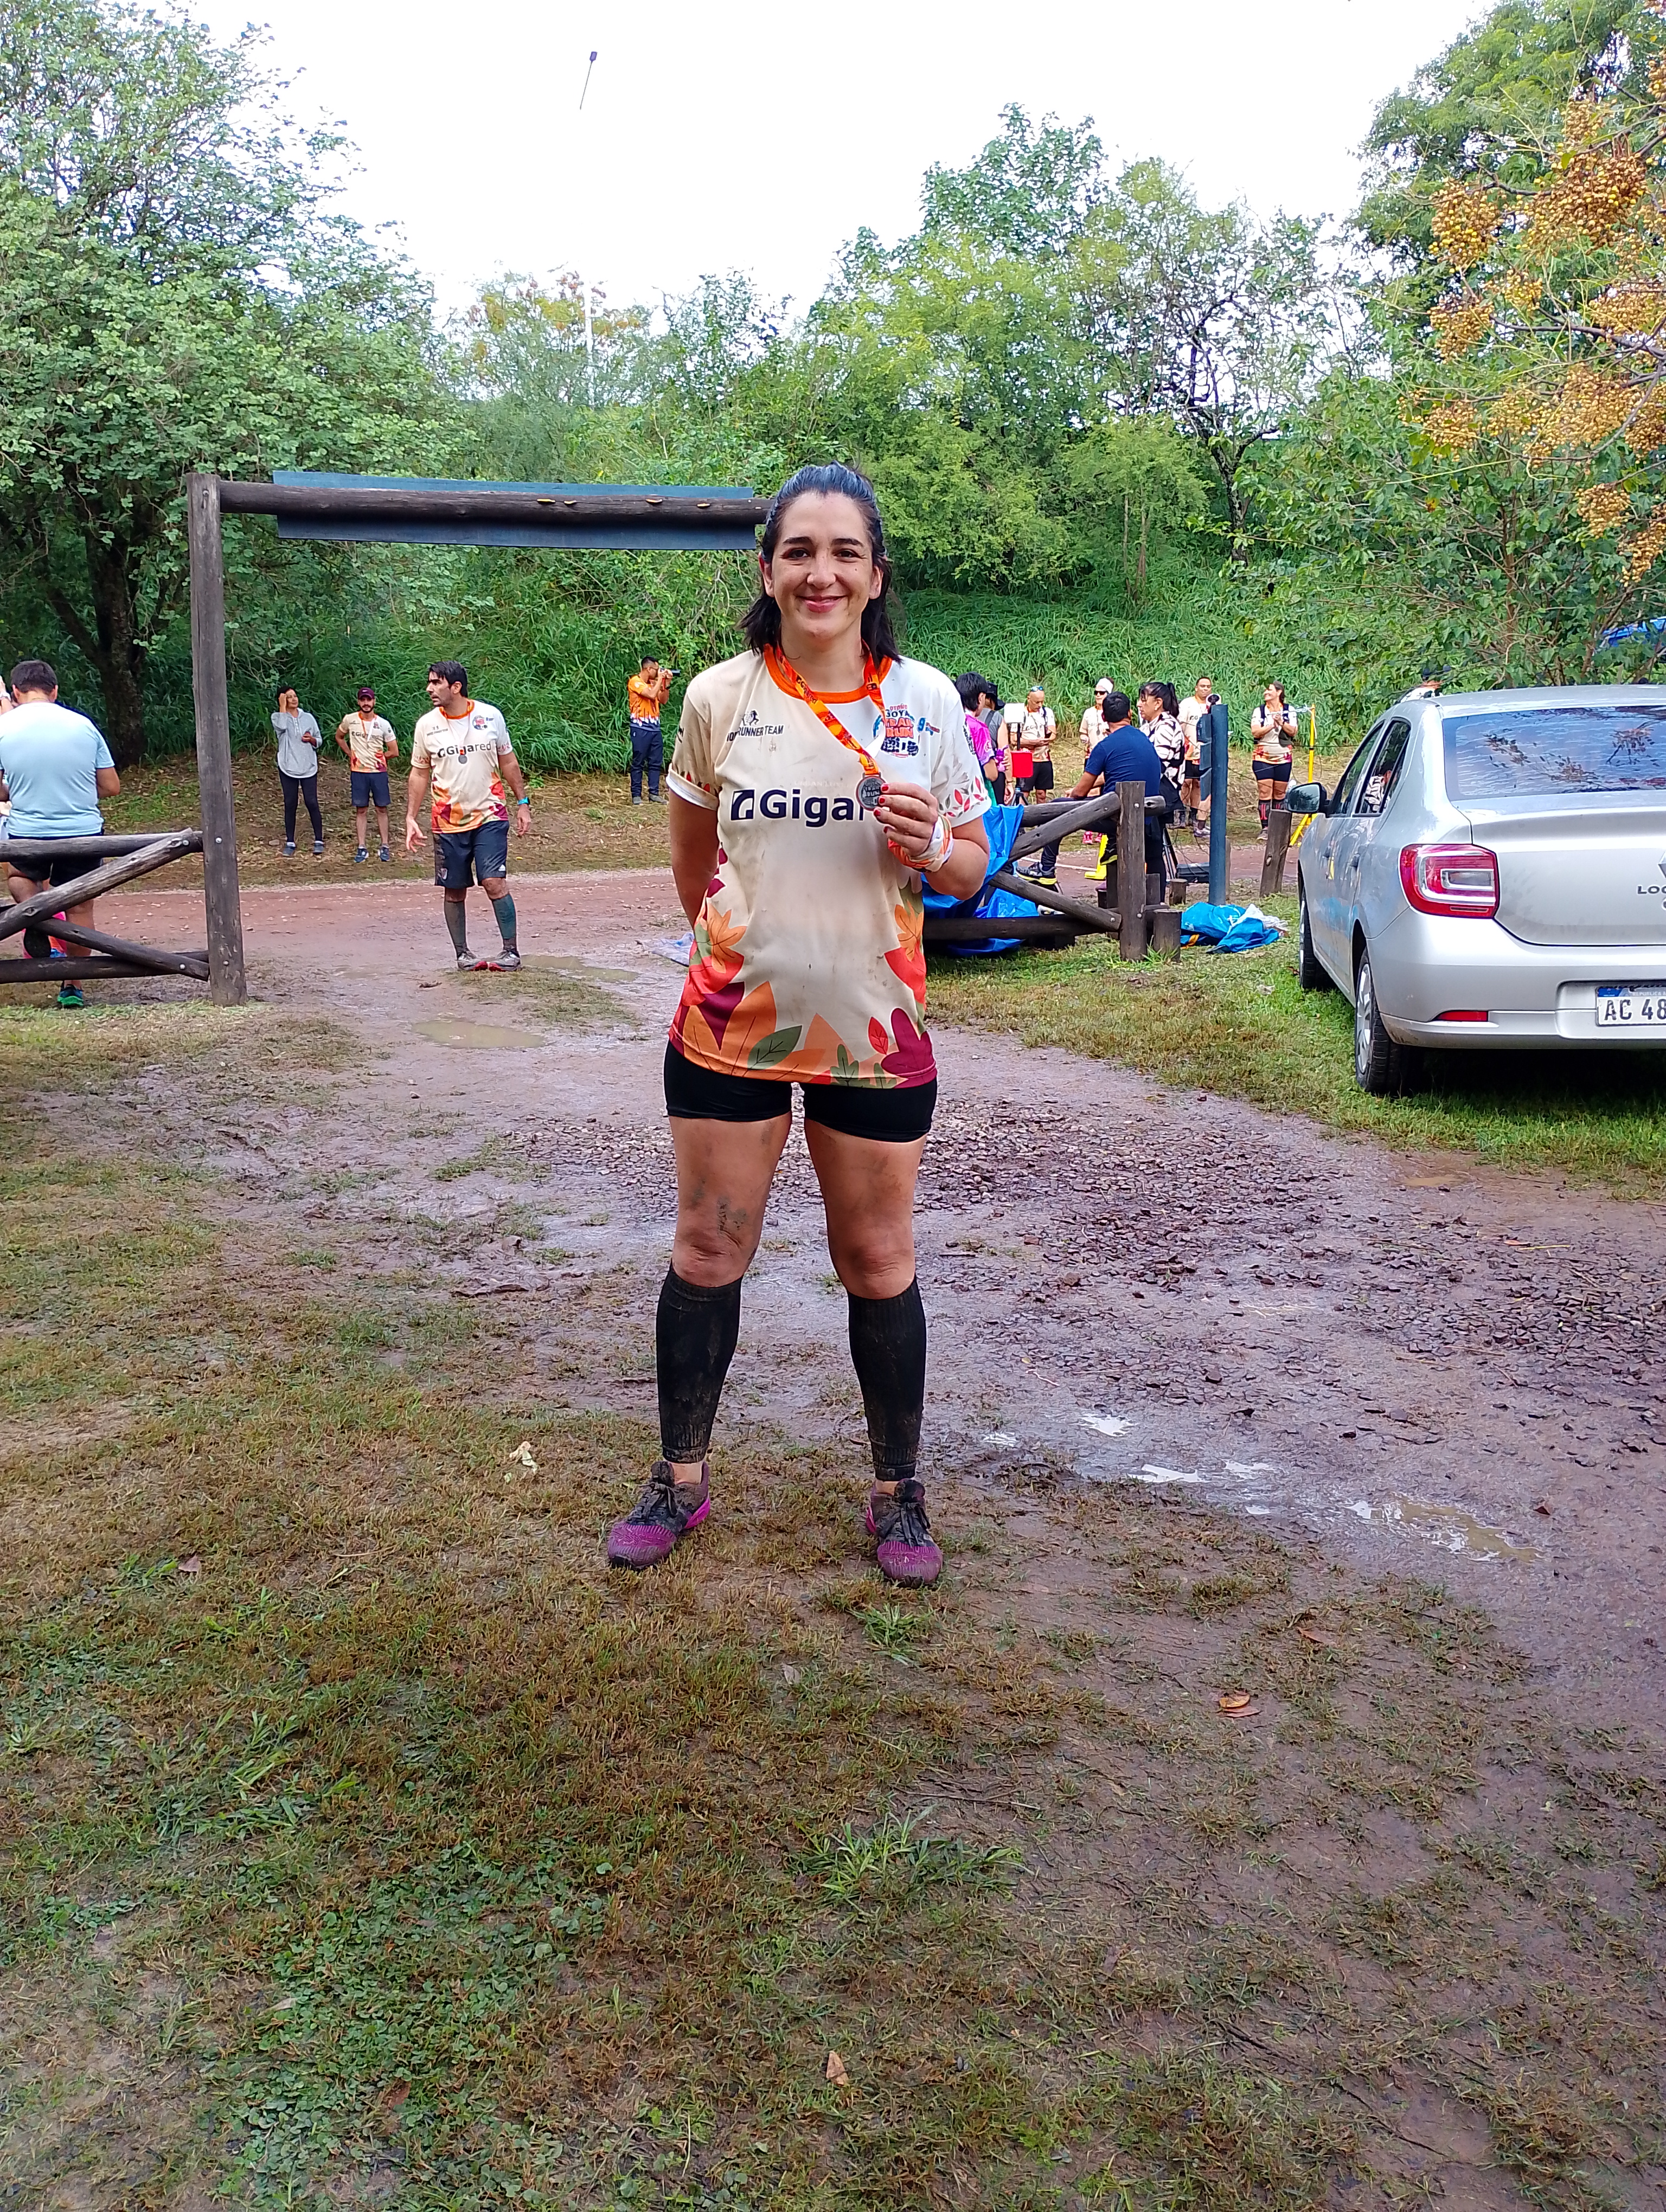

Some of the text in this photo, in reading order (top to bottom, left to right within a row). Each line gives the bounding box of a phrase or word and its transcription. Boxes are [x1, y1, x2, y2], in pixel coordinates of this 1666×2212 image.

[738, 727, 764, 736] RUNNER
[765, 725, 784, 735] TEAM
[886, 727, 914, 738] RUN
[760, 788, 864, 828] Giga
[1604, 999, 1666, 1020] AC 48
